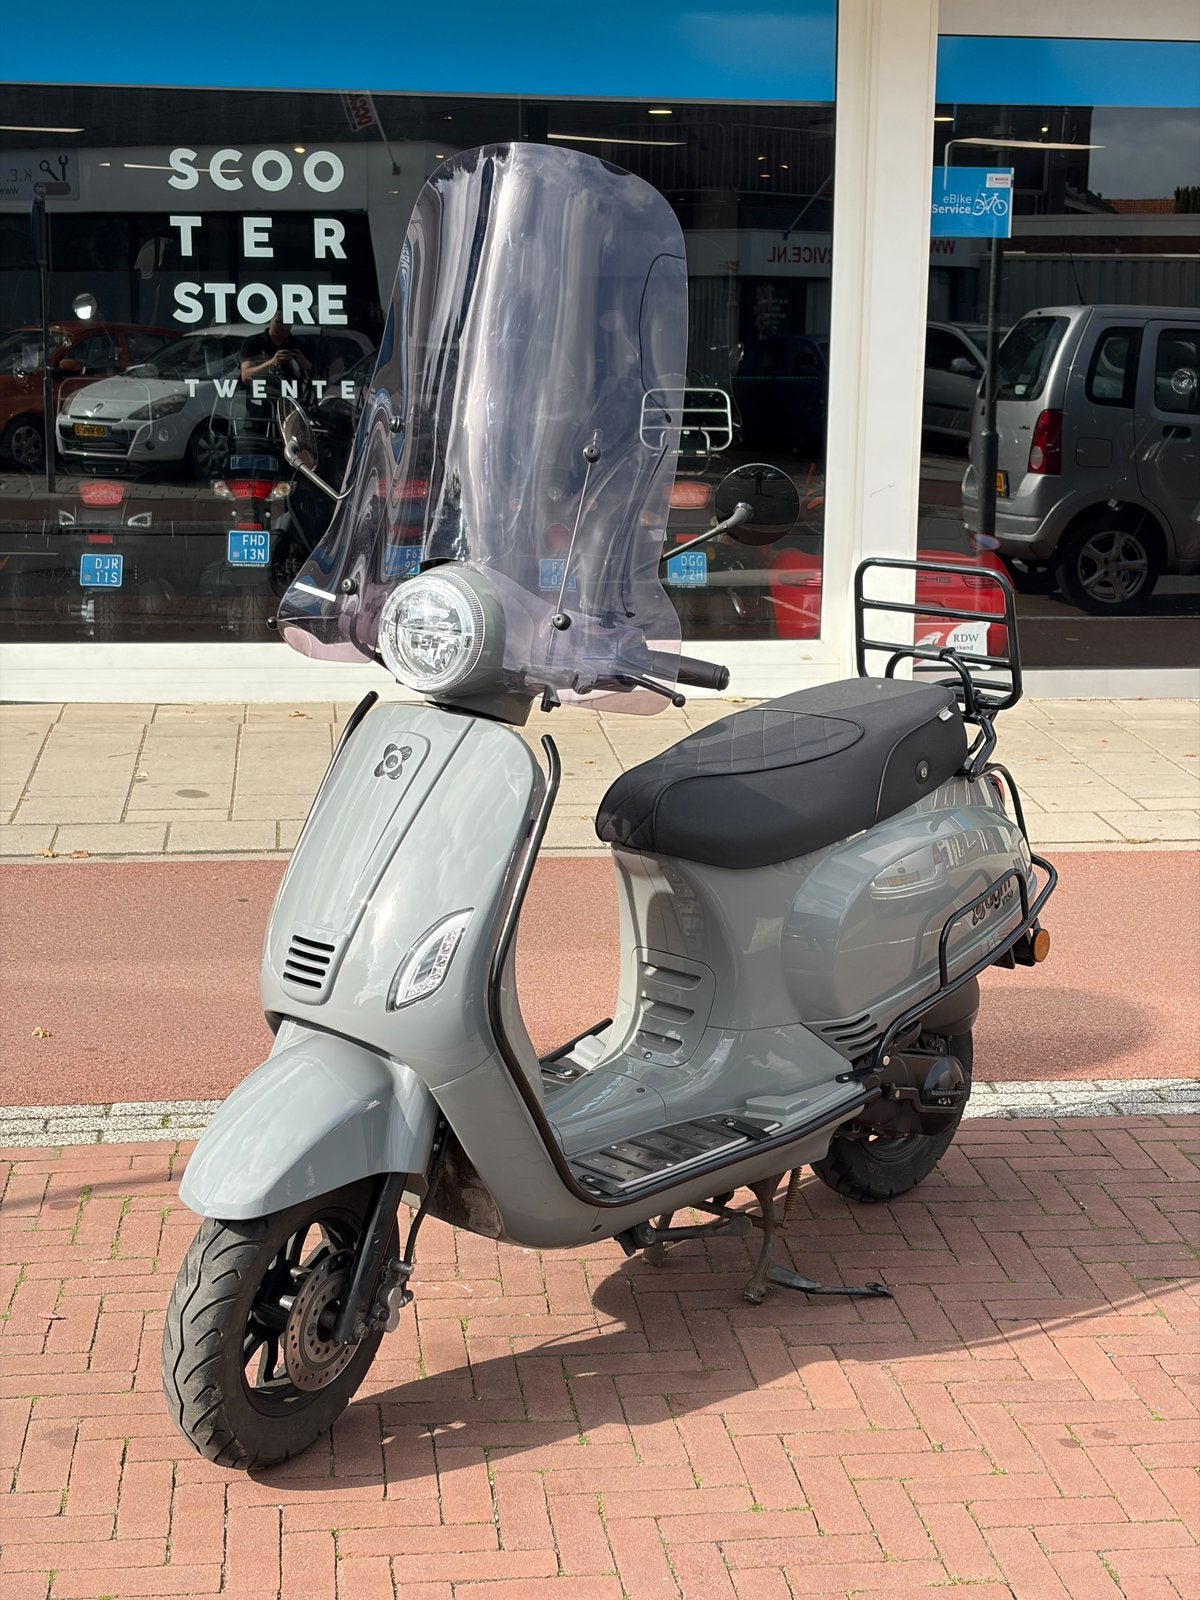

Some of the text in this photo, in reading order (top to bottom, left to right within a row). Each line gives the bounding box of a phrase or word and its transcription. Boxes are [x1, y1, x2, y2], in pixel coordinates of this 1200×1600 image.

[168, 148, 344, 192] SCOO
[943, 193, 972, 204] eBike
[932, 204, 972, 214] Service
[172, 281, 348, 324] STORE
[184, 378, 356, 400] TWENTE
[242, 534, 265, 546] FHD
[243, 548, 265, 560] 13N
[95, 557, 119, 569] DJR
[681, 555, 703, 566] DGG
[96, 571, 118, 583] 11S
[681, 569, 703, 580] 72H
[953, 633, 980, 643] RDW
